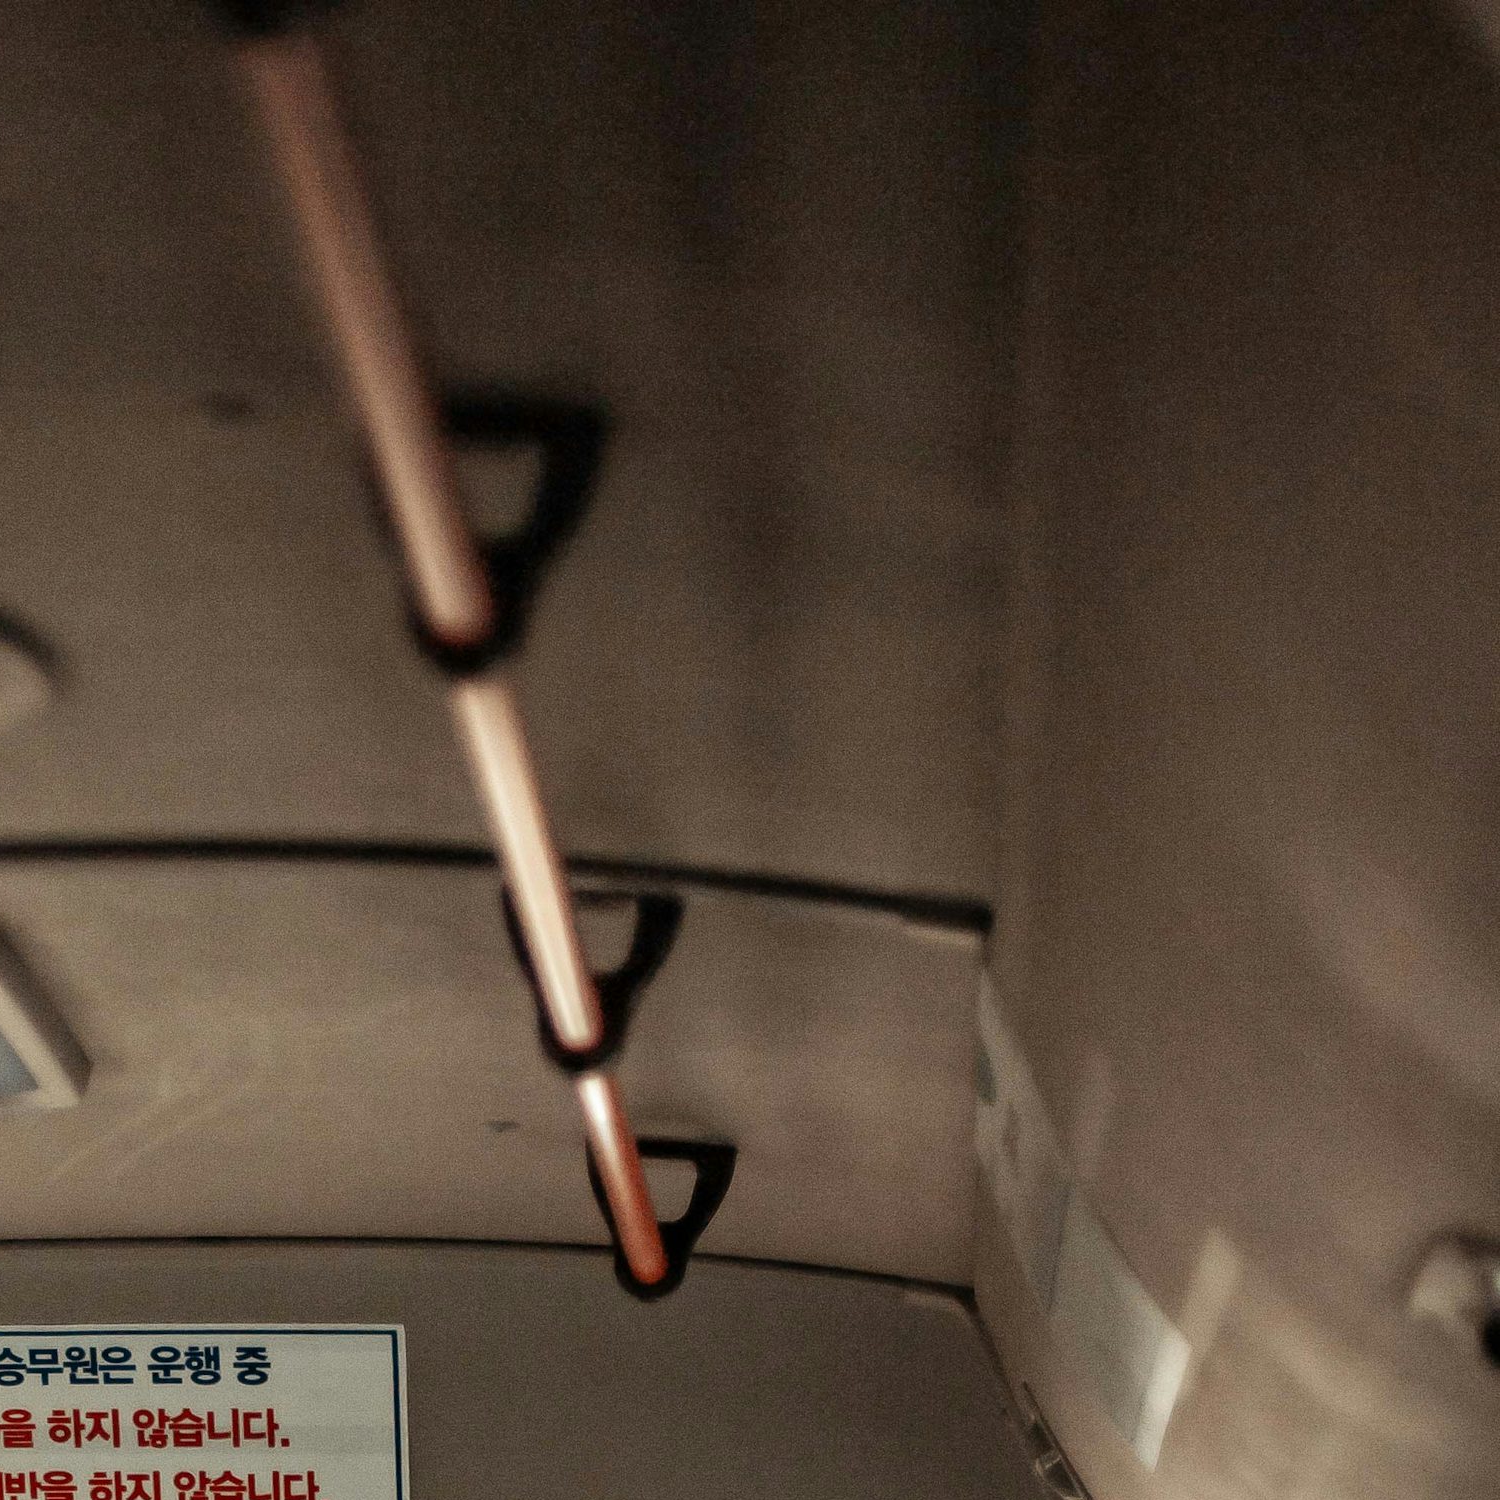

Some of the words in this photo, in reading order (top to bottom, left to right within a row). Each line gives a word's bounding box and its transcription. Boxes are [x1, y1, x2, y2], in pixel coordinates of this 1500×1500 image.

[148, 1346, 221, 1385] 운행
[233, 1346, 271, 1385] 중
[48, 1409, 120, 1448] 하지
[136, 1408, 290, 1447] 않습니다.
